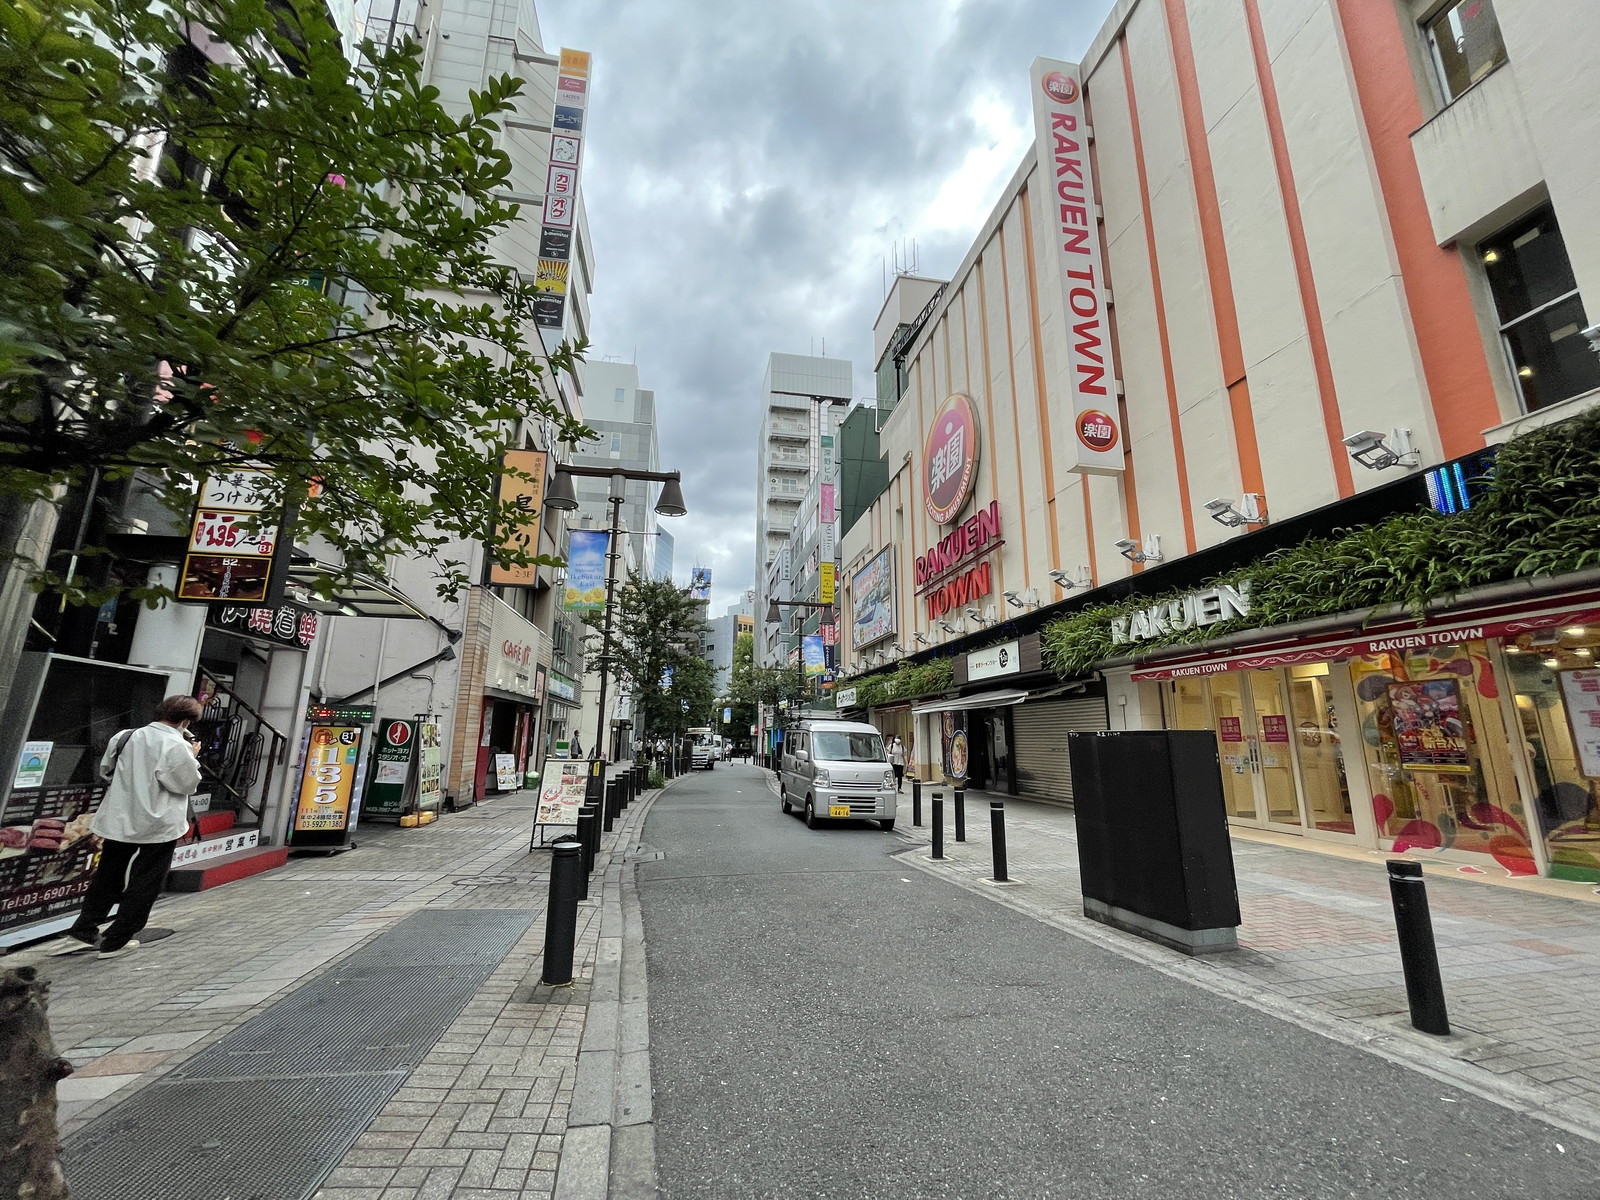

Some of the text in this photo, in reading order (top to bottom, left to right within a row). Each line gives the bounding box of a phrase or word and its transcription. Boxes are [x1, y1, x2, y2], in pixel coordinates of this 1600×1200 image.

[1049, 81, 1073, 96] 楽園
[551, 173, 571, 219] カラオケ
[1050, 112, 1107, 396] RAKUEN TOWN
[1083, 422, 1111, 440] 楽園
[930, 424, 964, 496] 楽園
[944, 456, 972, 522] AMUSEMENT
[916, 499, 1001, 586] RAKUEN
[925, 561, 991, 621] TOWN
[1111, 579, 1252, 645] RAKUEN
[1369, 627, 1483, 652] RAKUEN TOWN
[1171, 662, 1228, 678] RAKUEN TOWN
[342, 731, 353, 741] B1
[225, 833, 257, 852] 営業中
